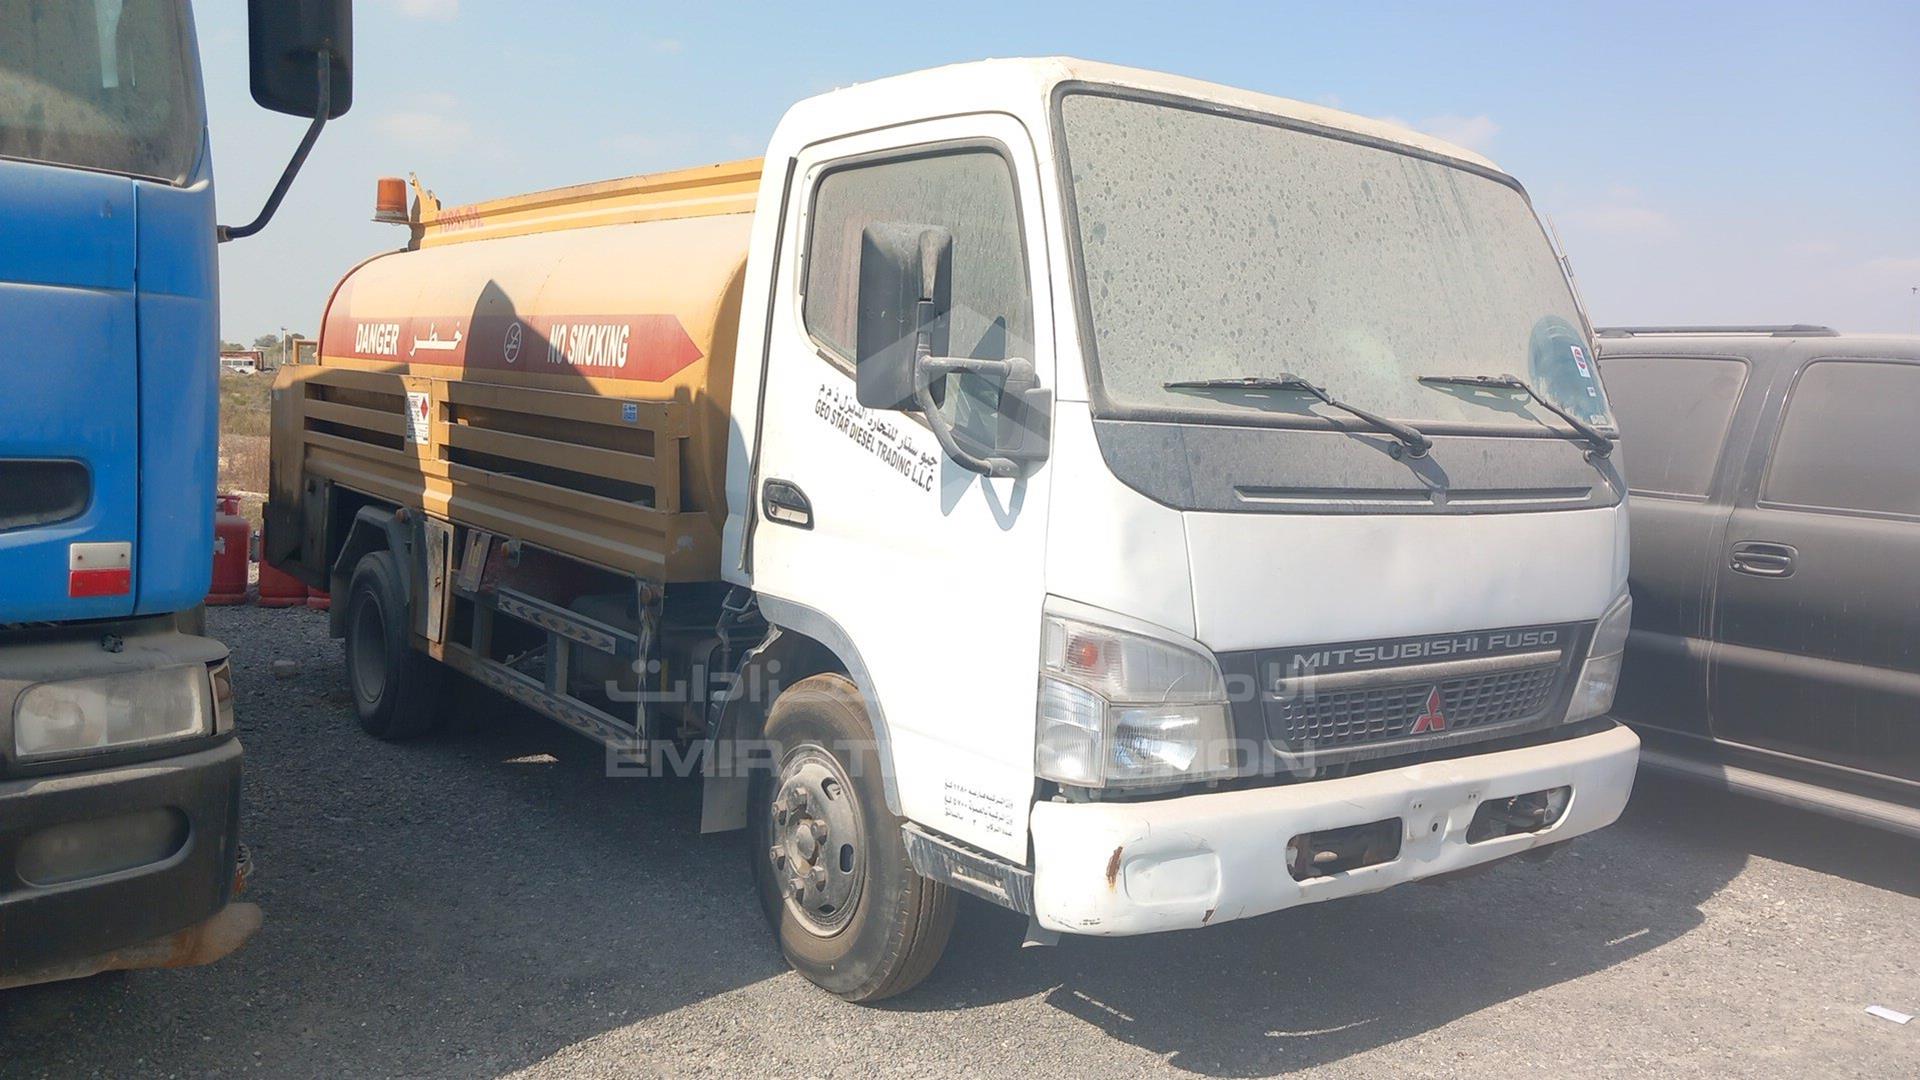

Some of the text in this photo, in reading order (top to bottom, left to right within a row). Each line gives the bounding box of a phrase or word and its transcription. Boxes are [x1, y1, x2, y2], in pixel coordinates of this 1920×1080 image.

[355, 323, 400, 355] DANGER
[409, 321, 463, 357] خطر
[547, 324, 630, 368] NO SMOKING
[815, 398, 934, 492] GEO STAR DIESEL TRADING L.L.C
[1293, 630, 1557, 669] MITSUBISHI FUSO
